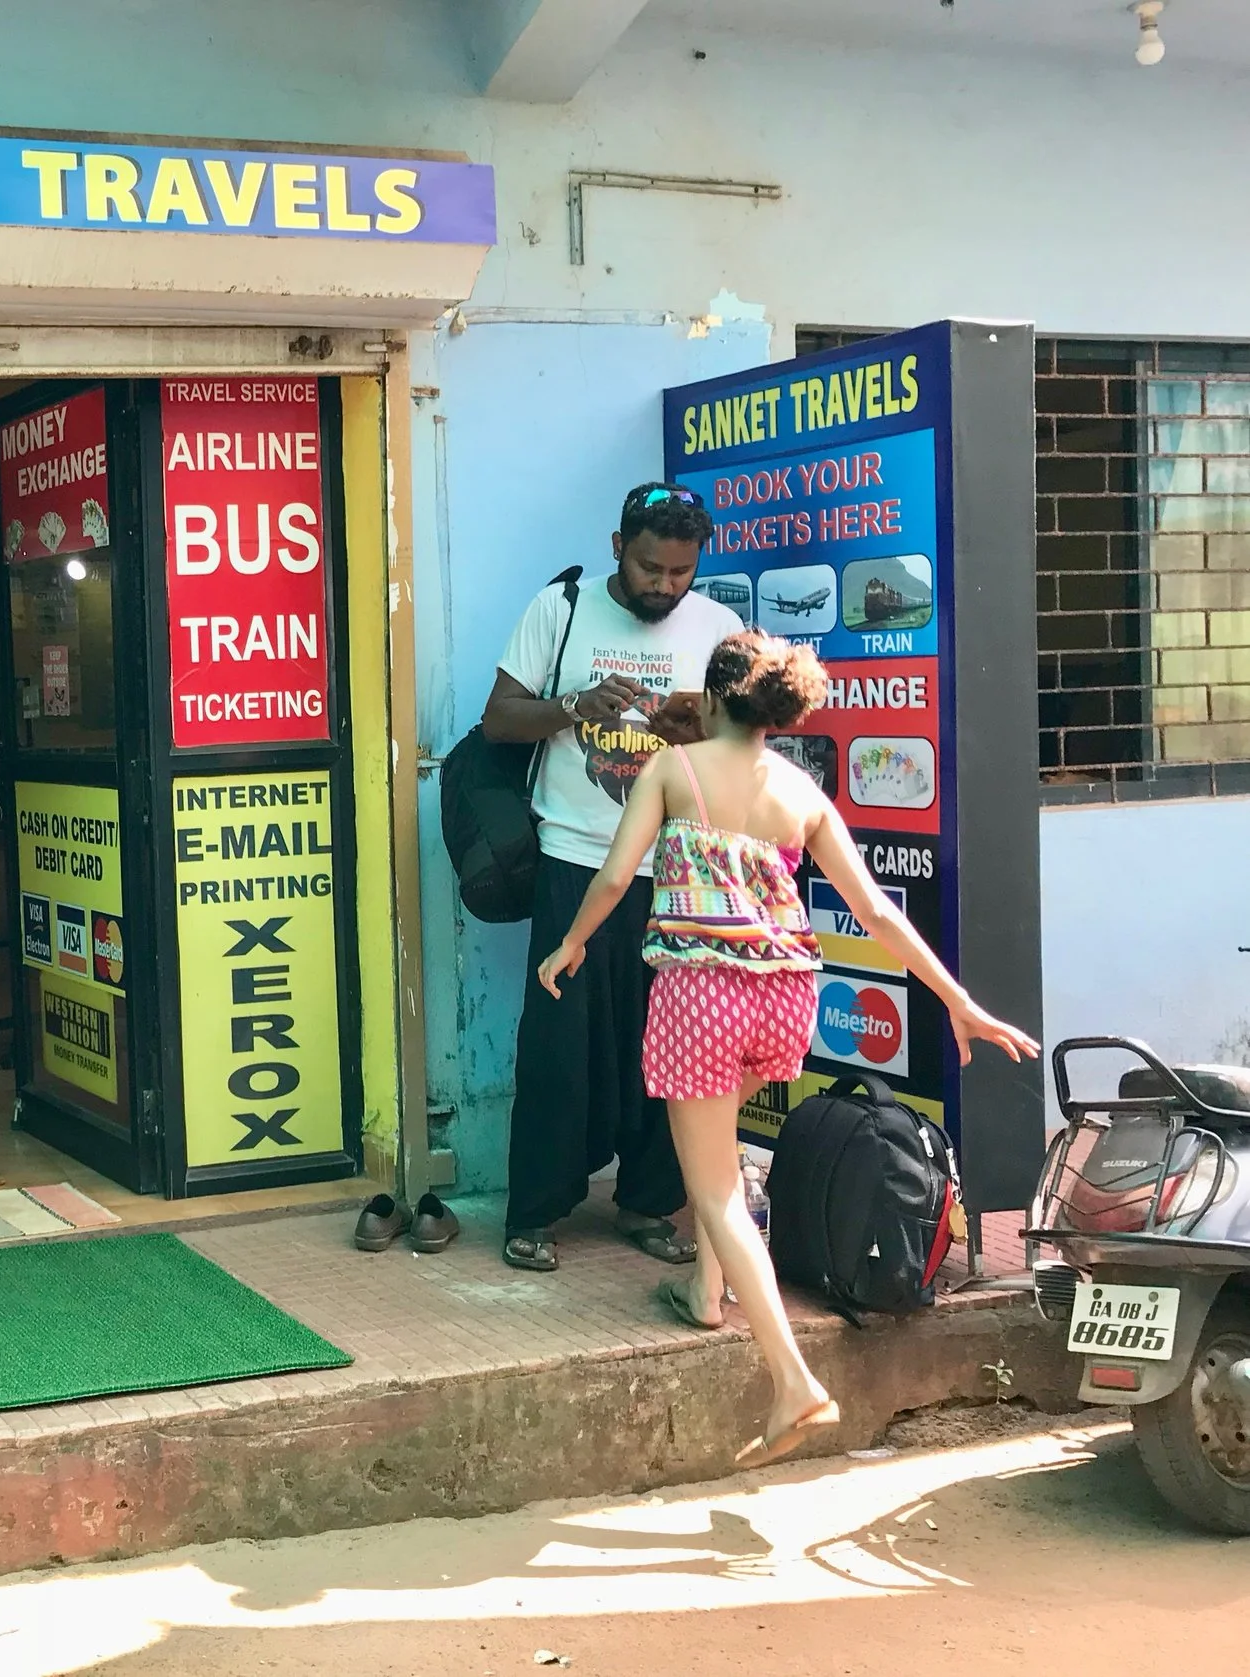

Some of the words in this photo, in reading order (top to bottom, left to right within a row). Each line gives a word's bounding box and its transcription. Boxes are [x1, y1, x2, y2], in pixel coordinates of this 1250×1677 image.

[24, 150, 423, 235] TRAVELS
[166, 383, 236, 402] TRAVEL
[240, 383, 316, 402] SERVICE
[683, 386, 782, 455] SANKET
[790, 355, 920, 434] TRAVELS
[1, 406, 68, 461] MONEY
[168, 432, 318, 471] AIRLINE
[18, 444, 107, 497] EXCHANGE
[714, 466, 792, 509] BOOK
[798, 451, 884, 497] YOUR
[818, 498, 902, 541] HERE
[174, 502, 320, 576] BUS
[180, 614, 318, 663] TRAIN
[862, 632, 913, 654] TRAIN
[592, 659, 672, 674] ANNOYING
[593, 648, 617, 658] Isn't
[620, 650, 638, 660] the
[640, 651, 672, 662] beard
[180, 689, 323, 723] TICKETING
[591, 755, 642, 779] Seaso
[177, 782, 328, 812] INTERNET
[20, 810, 48, 837] CASH
[52, 816, 69, 840] ON
[177, 821, 333, 862] E-MAIL
[35, 849, 67, 875] DEBIT
[71, 855, 103, 881] CARD
[873, 845, 934, 879] CARDS
[180, 873, 332, 905] PRINTING
[29, 903, 43, 922] VISA
[27, 934, 50, 957] Electron
[62, 924, 82, 953] VISA
[94, 938, 123, 963] MasterCard
[45, 991, 97, 1029] WESTERN
[824, 1006, 894, 1039] Maestro
[61, 1019, 98, 1052] UNION
[223, 916, 303, 1151] XEROX
[54, 1044, 75, 1064] MONEY
[76, 1052, 109, 1079] TRANSFER
[738, 1106, 782, 1127] RANSFER
[1102, 1159, 1148, 1168] SUZUKI
[1118, 1302, 1142, 1320] 08
[1146, 1303, 1159, 1321] J
[1072, 1321, 1170, 1351] 8685
